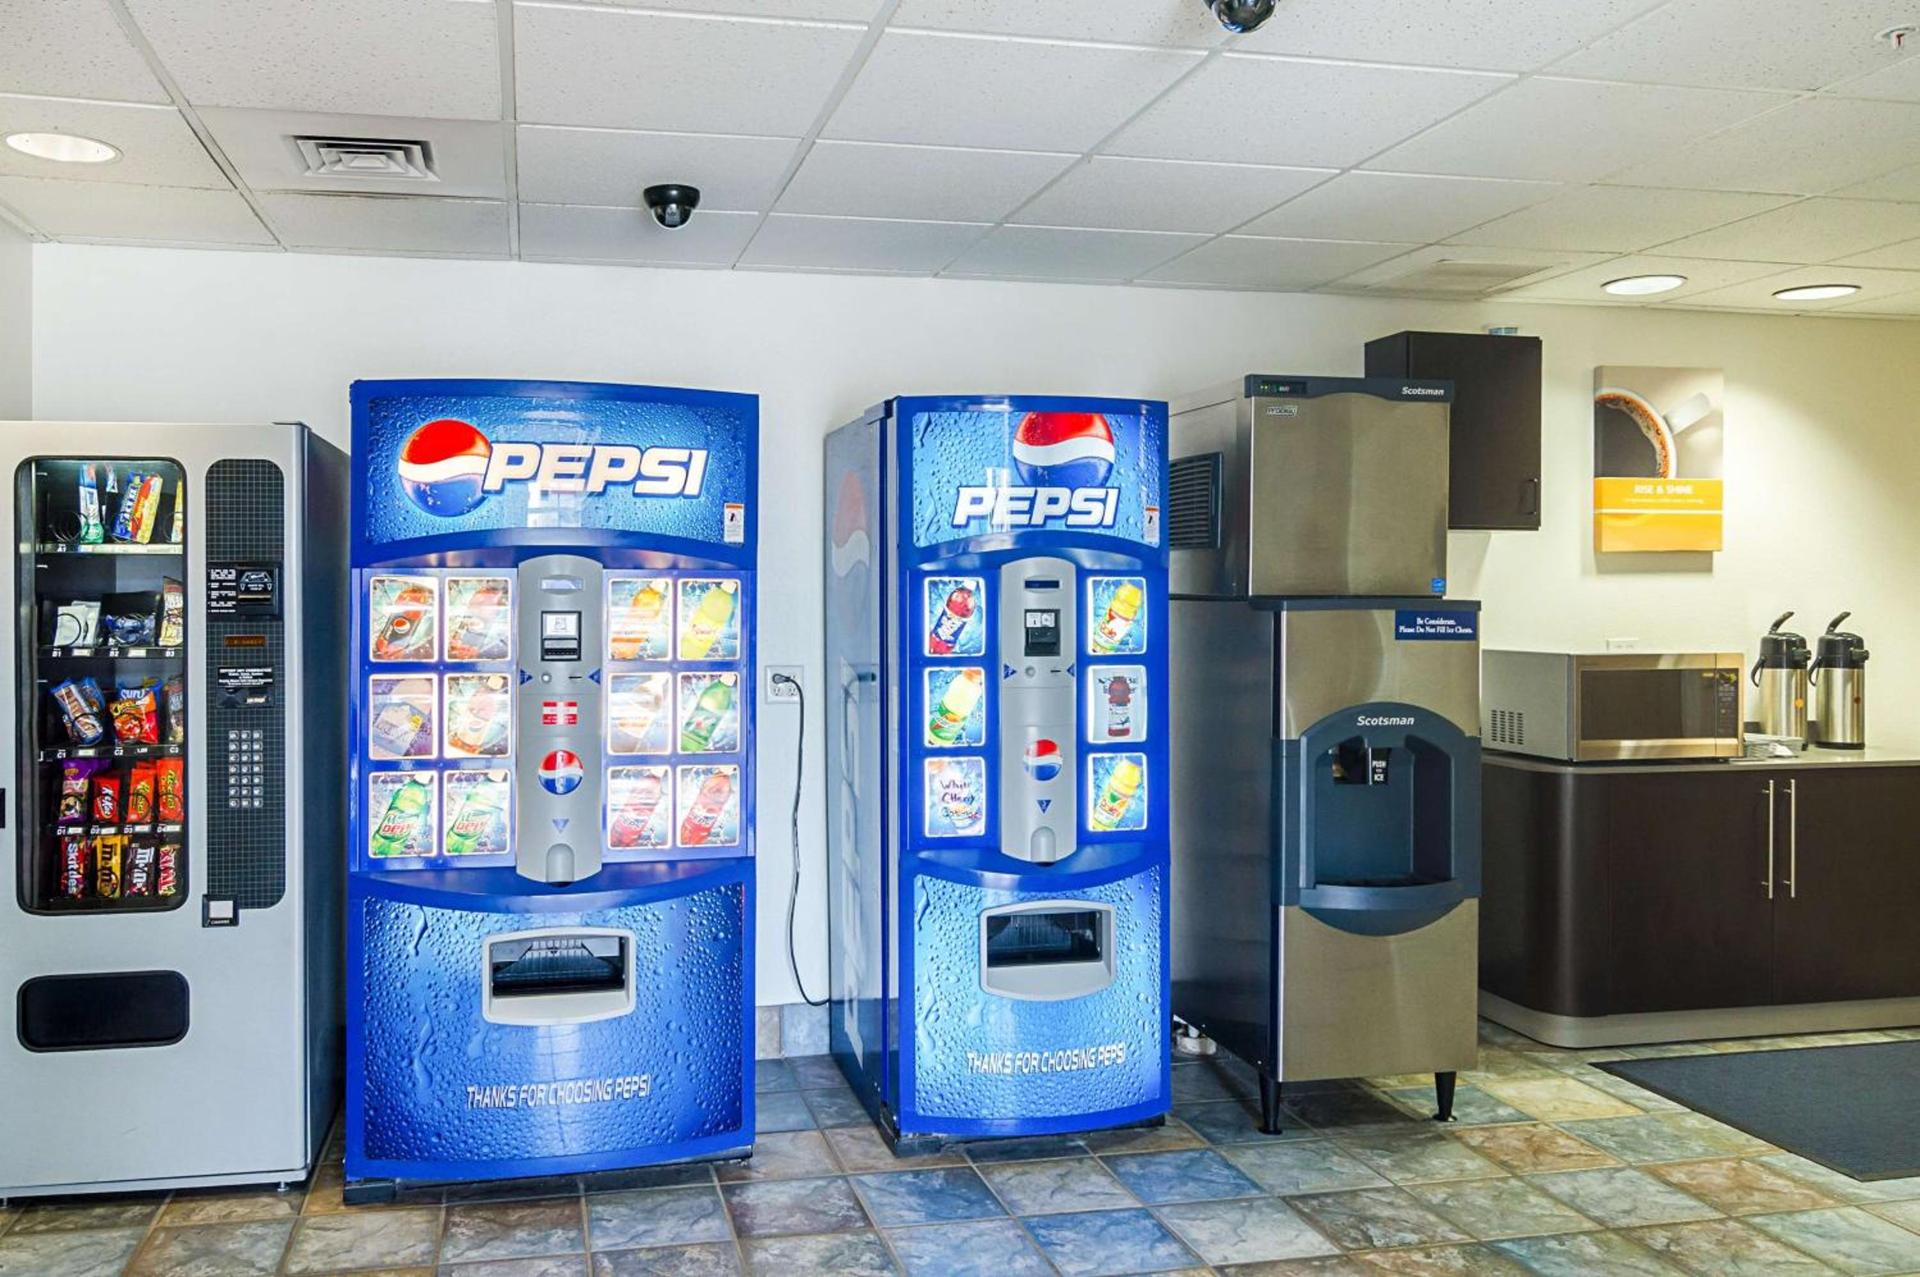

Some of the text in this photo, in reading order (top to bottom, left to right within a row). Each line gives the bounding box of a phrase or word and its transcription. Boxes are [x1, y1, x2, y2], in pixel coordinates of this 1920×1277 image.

[1401, 386, 1445, 396] Scotsman
[483, 442, 708, 498] PEPSI
[952, 486, 1121, 528] PEPSI
[1356, 715, 1415, 727] Scotsman
[1371, 760, 1387, 768] PUSH
[966, 1041, 1127, 1074] THANKS FOR CHOOSING PEPSI
[466, 1074, 651, 1110] THANKS FOR CHOOSING PEPSI
